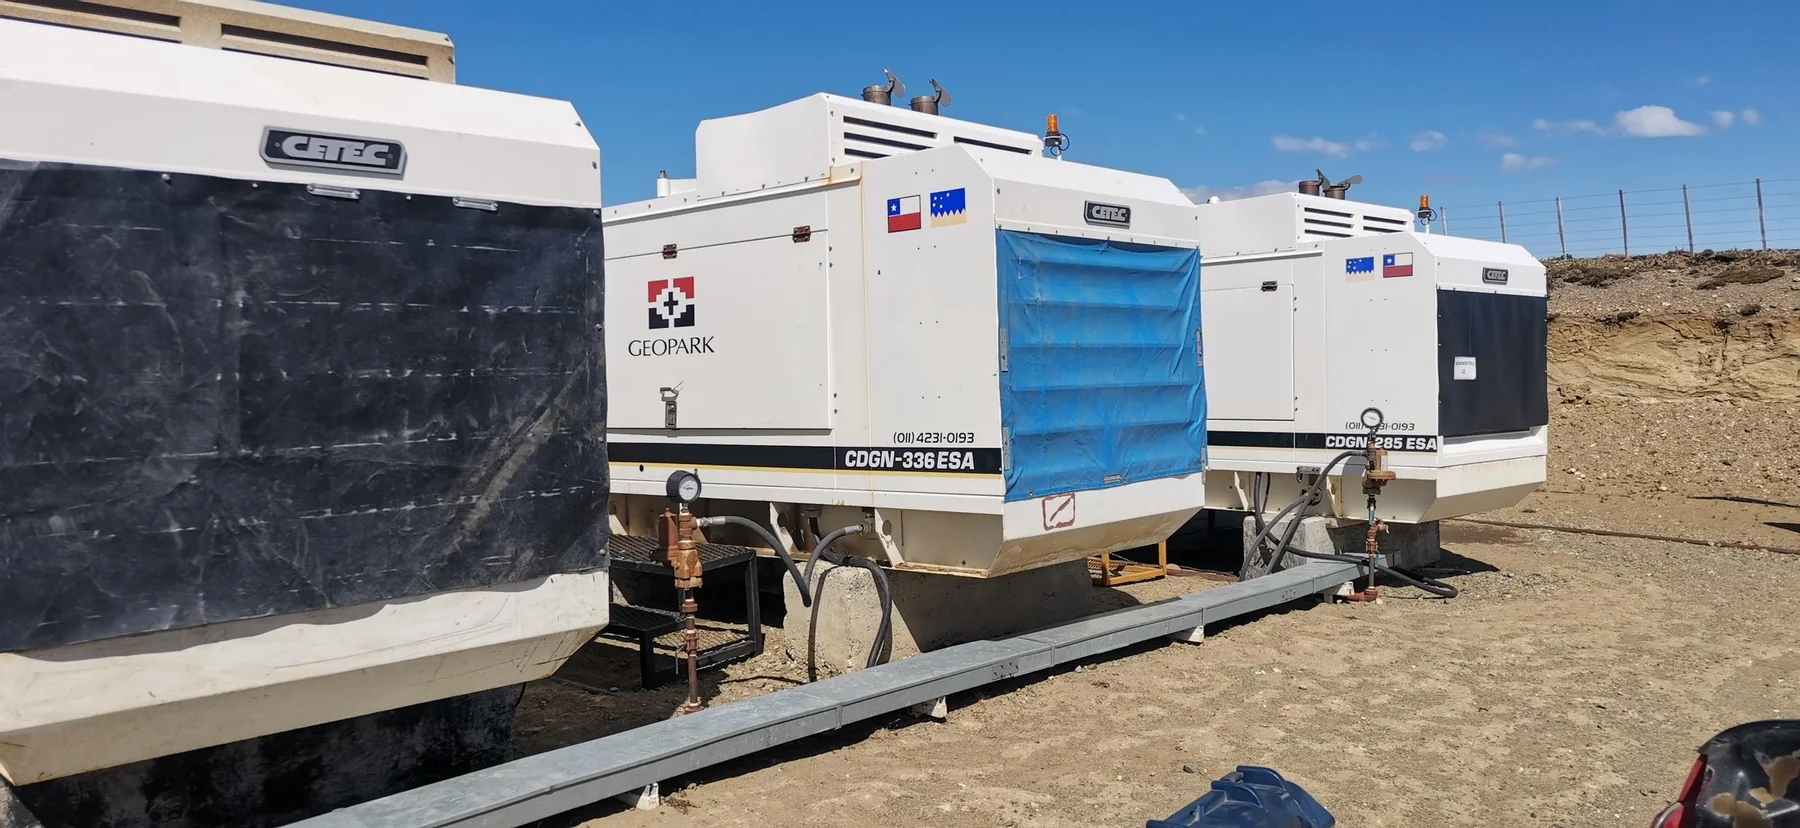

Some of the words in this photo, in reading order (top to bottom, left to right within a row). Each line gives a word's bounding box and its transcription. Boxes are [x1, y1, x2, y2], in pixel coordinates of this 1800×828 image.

[282, 135, 389, 165] CETEC
[1092, 206, 1126, 221] CETEC
[628, 336, 715, 357] GEOPARK
[1345, 421, 1364, 431] (011)
[893, 432, 914, 444] (011)
[916, 432, 975, 444] 4231-0193
[1406, 438, 1438, 450] ESA
[845, 450, 936, 469] CDGN-336
[937, 452, 975, 470] ESA
